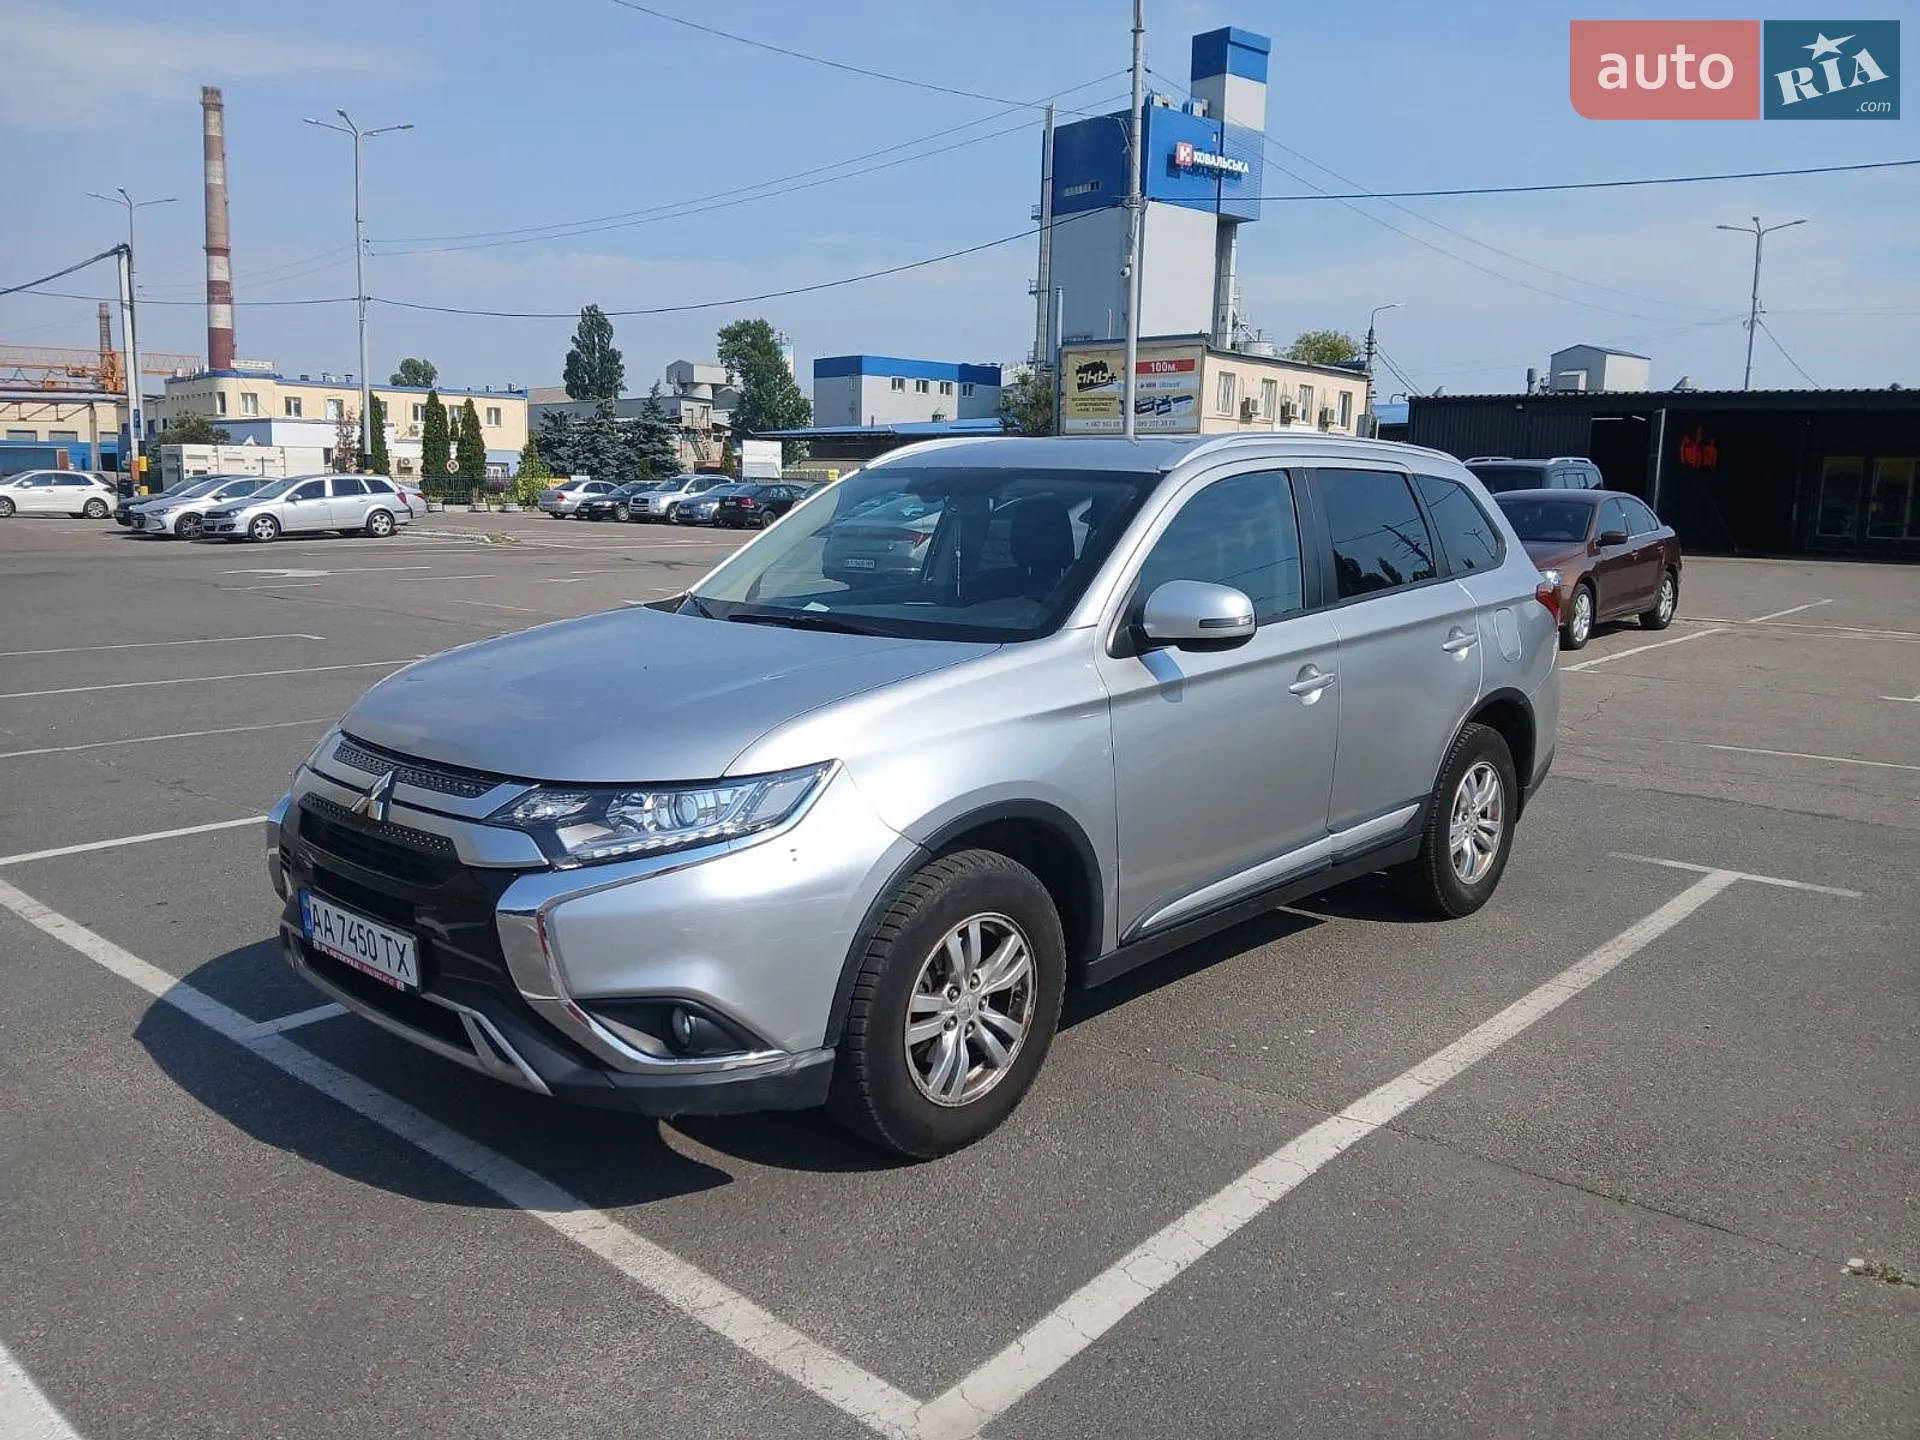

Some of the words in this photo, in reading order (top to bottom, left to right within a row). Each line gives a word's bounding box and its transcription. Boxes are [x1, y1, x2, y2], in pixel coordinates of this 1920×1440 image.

[1193, 151, 1249, 173] КОВАЛЬСЬКА
[312, 904, 334, 943] AA
[337, 914, 378, 962] 7450
[380, 934, 411, 977] TX
